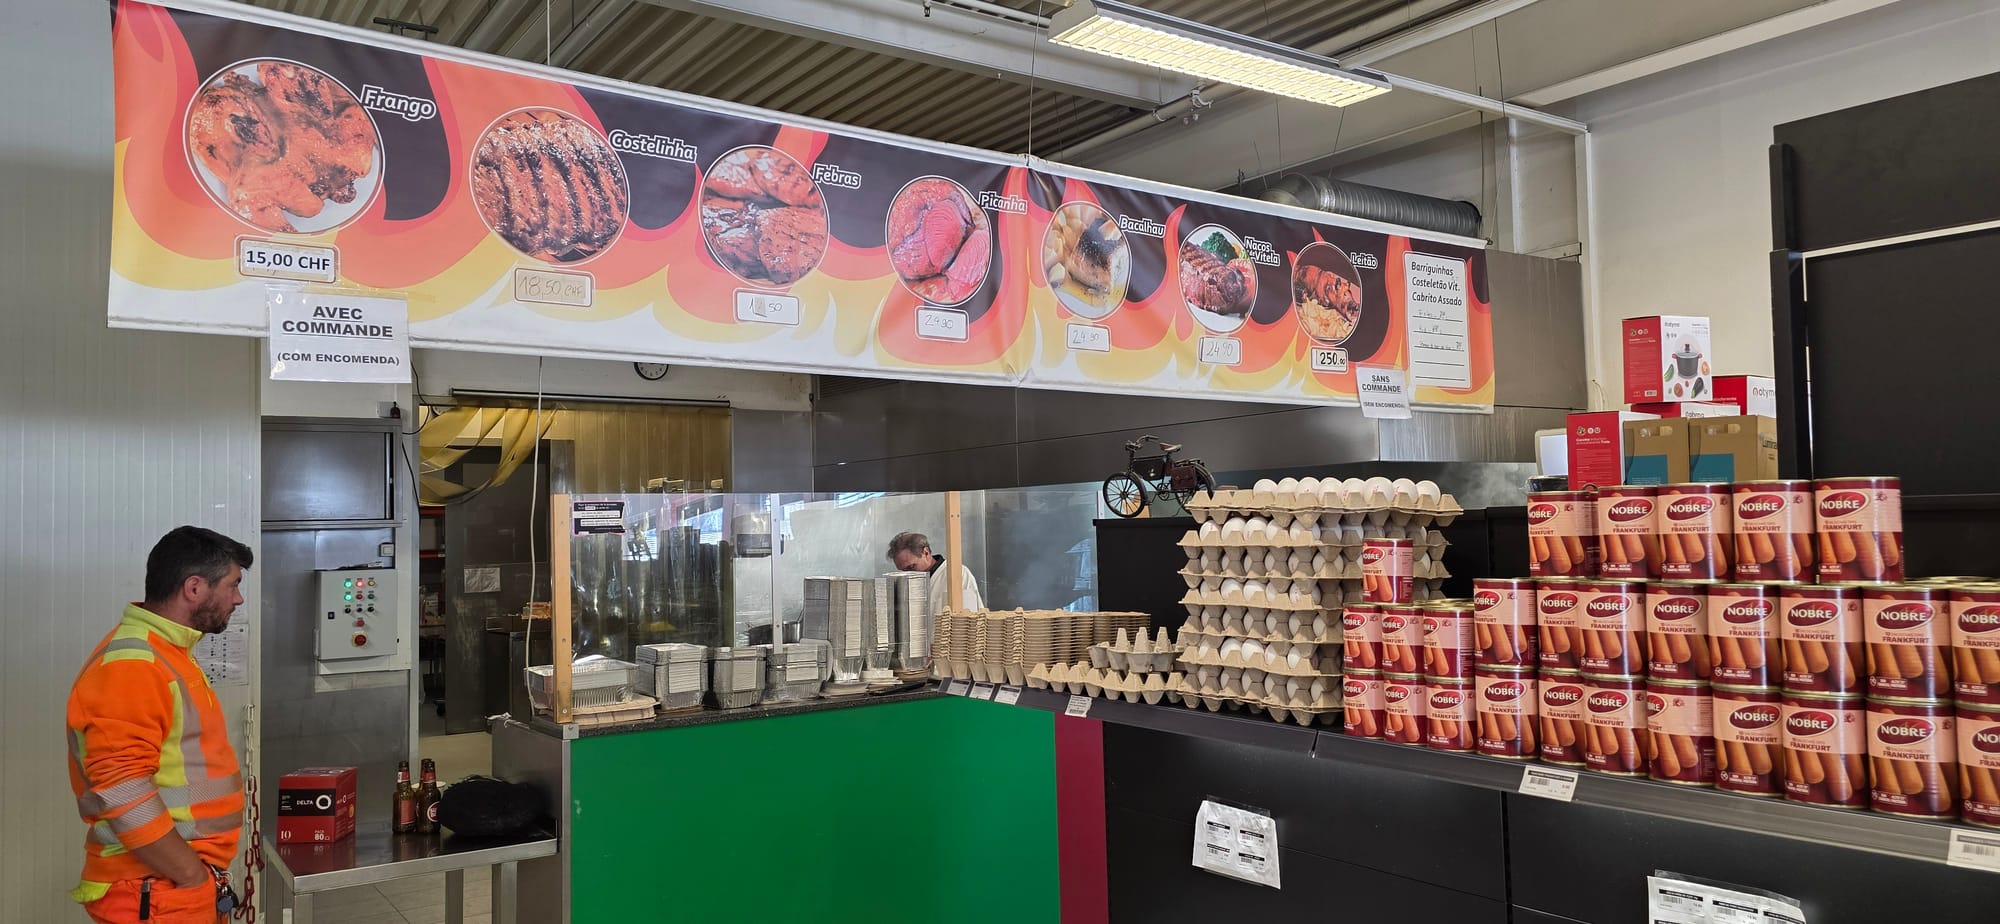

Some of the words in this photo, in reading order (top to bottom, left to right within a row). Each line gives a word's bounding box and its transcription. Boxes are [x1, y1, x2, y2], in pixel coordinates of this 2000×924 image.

[363, 88, 434, 119] Frango
[610, 132, 695, 162] Costelinha
[815, 165, 860, 187] Febras
[980, 193, 1026, 212] Picanha
[1120, 217, 1165, 237] Bacalhau
[1246, 238, 1270, 252] Nacos
[246, 250, 293, 267] 15,00
[298, 256, 330, 271] CHF
[1255, 250, 1278, 264] Vitela
[1352, 254, 1377, 268] Leitão
[1411, 261, 1454, 276] Barriguinhas
[518, 276, 562, 300] 18,50
[1412, 276, 1447, 290] Costeletão
[1448, 282, 1460, 292] Vit.
[1412, 292, 1437, 304] Cabrito
[1438, 295, 1462, 306] Assado
[313, 306, 363, 320] AVEC
[282, 320, 393, 338] COMMANDE
[278, 352, 312, 362] (COM
[316, 354, 400, 366] ENCOMENDA)
[1372, 374, 1390, 382] SANS
[1362, 384, 1401, 392] COMMANDE
[1611, 506, 1648, 515] NOBRE
[1670, 503, 1708, 513] NOBRE
[1740, 502, 1779, 512] NOBRE
[1821, 500, 1860, 510] NOBRE
[1542, 599, 1573, 608] NOBRE
[1589, 602, 1625, 611] NOBRE
[1657, 604, 1694, 614] NOBRE
[1727, 606, 1768, 616] NOBRE
[1791, 608, 1832, 619] NOBRE
[1880, 611, 1926, 622] NOBRE
[1961, 614, 2000, 624] NOBR
[1488, 688, 1520, 696] NOBRE
[1546, 692, 1578, 700] NOBRE
[1590, 697, 1622, 707] NOBRE
[1734, 711, 1775, 722] NOBRE
[1788, 717, 1828, 729] NOBRE
[1881, 725, 1927, 737] NOBRE
